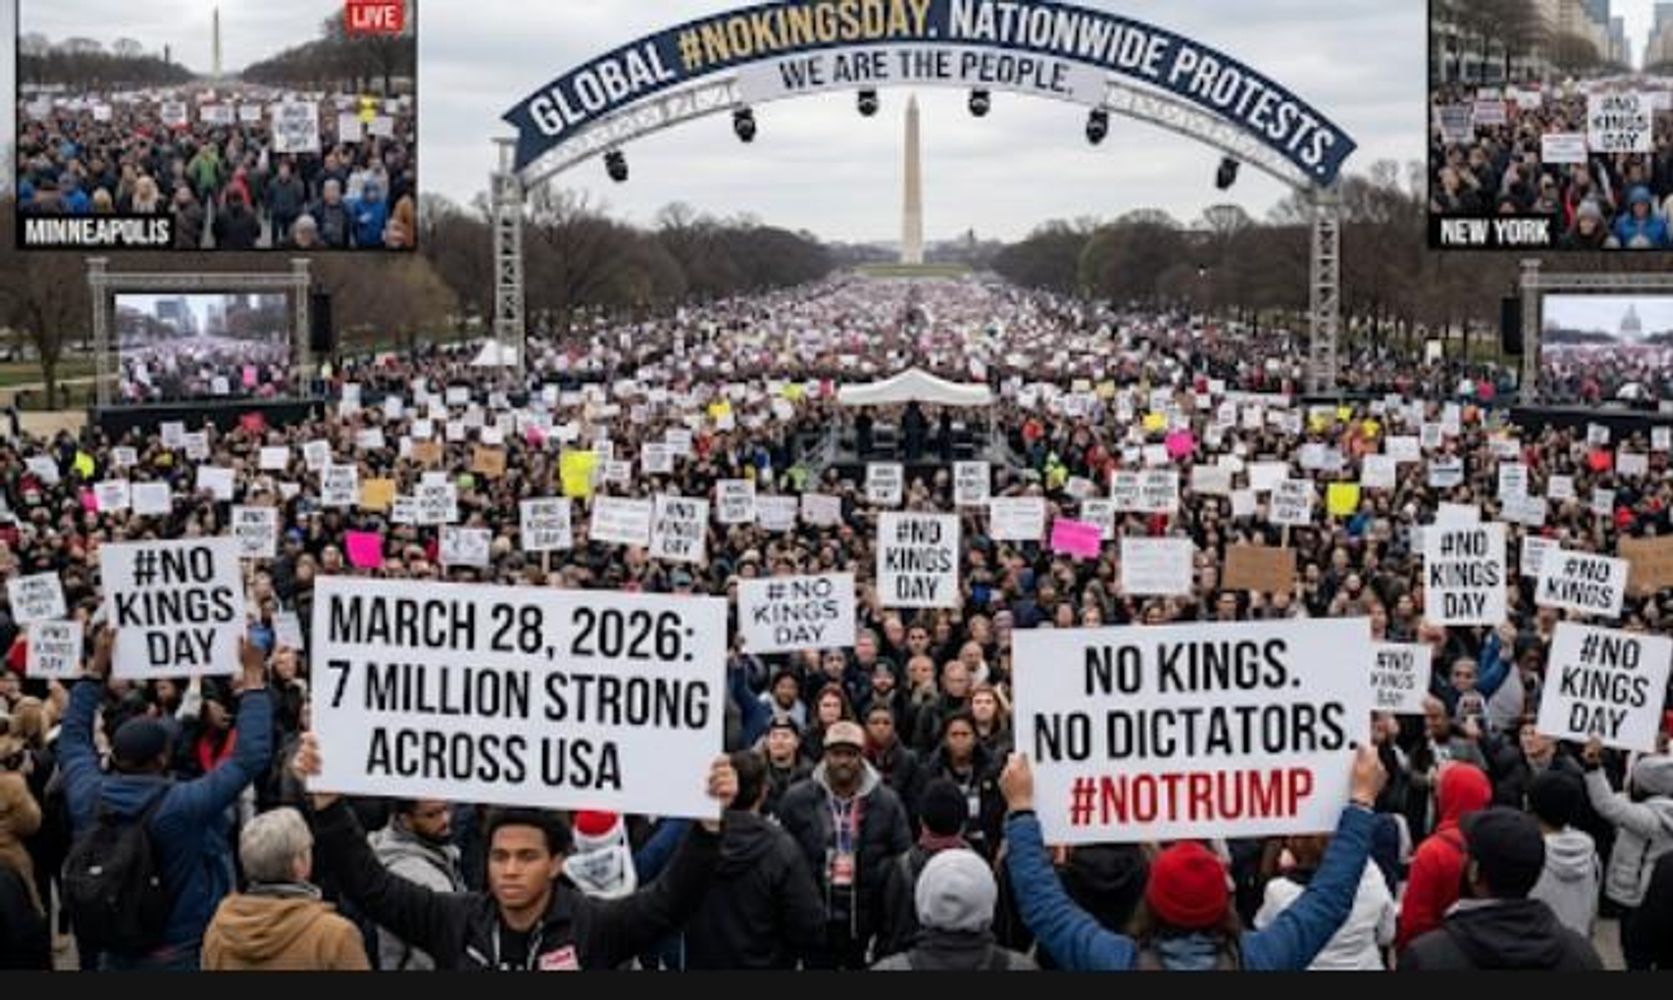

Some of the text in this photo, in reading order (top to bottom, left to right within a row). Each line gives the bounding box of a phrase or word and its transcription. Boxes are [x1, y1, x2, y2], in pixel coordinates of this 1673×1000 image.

[529, 0, 1335, 174] GLOBAL #NOKINGSDAY. NATIONWIDE PROTESTS.
[780, 50, 1074, 95] WE ARE THE PEOPLE.
[896, 516, 942, 544] #NO
[1440, 530, 1488, 557] #NO
[133, 547, 214, 586] #NO
[886, 548, 952, 573] KINGS
[1430, 560, 1500, 588] KINGS
[1562, 557, 1611, 584] #NO
[114, 586, 234, 627] KINGS
[766, 577, 832, 601] #NO
[896, 576, 940, 601] DAY
[1445, 592, 1487, 619] DAY
[1546, 576, 1614, 608] KINGS
[328, 594, 696, 662] MARCH 28, 2026:
[752, 601, 840, 625] KINGS
[146, 628, 217, 666] DAY
[775, 625, 825, 647] DAY
[1580, 635, 1641, 669] #NO
[1084, 638, 1301, 696] NO KINGS.
[327, 660, 711, 730] 7 MILLION STRONG
[1559, 667, 1649, 708] KINGS
[1034, 702, 1358, 762] NO DICTATORS.
[1568, 702, 1627, 738] DAY
[366, 727, 623, 790] ACROSS USA
[1070, 767, 1315, 827] #NOTRUMP
